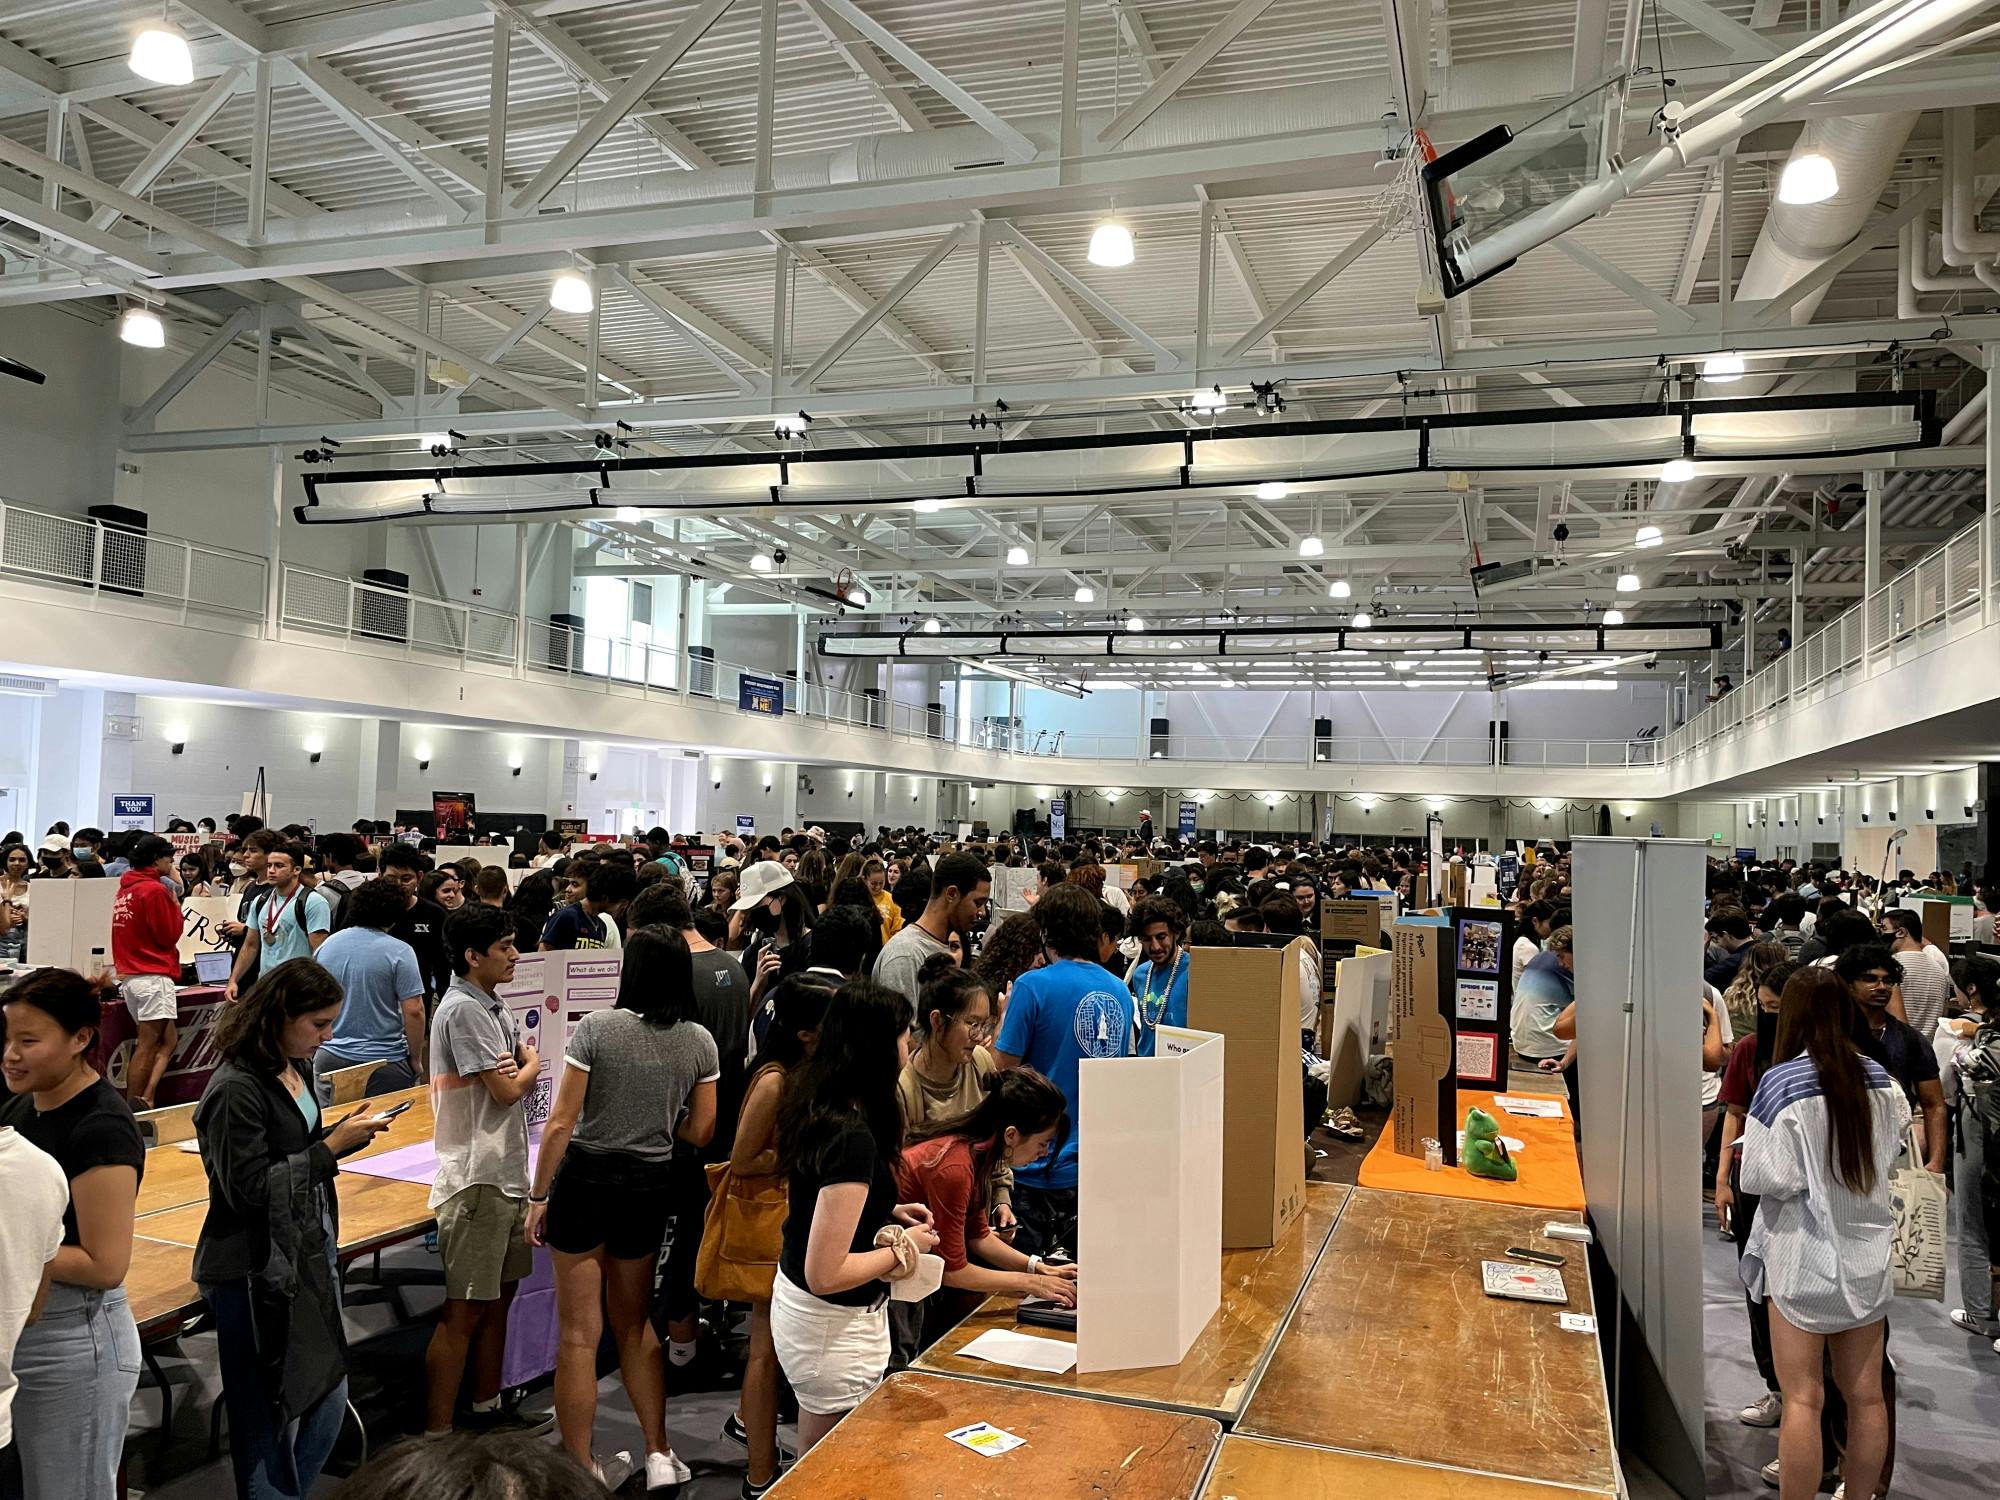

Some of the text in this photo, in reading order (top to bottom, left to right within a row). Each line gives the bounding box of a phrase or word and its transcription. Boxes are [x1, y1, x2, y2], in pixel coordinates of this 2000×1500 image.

[1416, 933, 1426, 957] Pacon
[570, 964, 587, 973] What
[588, 963, 596, 973] do
[1167, 1043, 1181, 1053] Who
